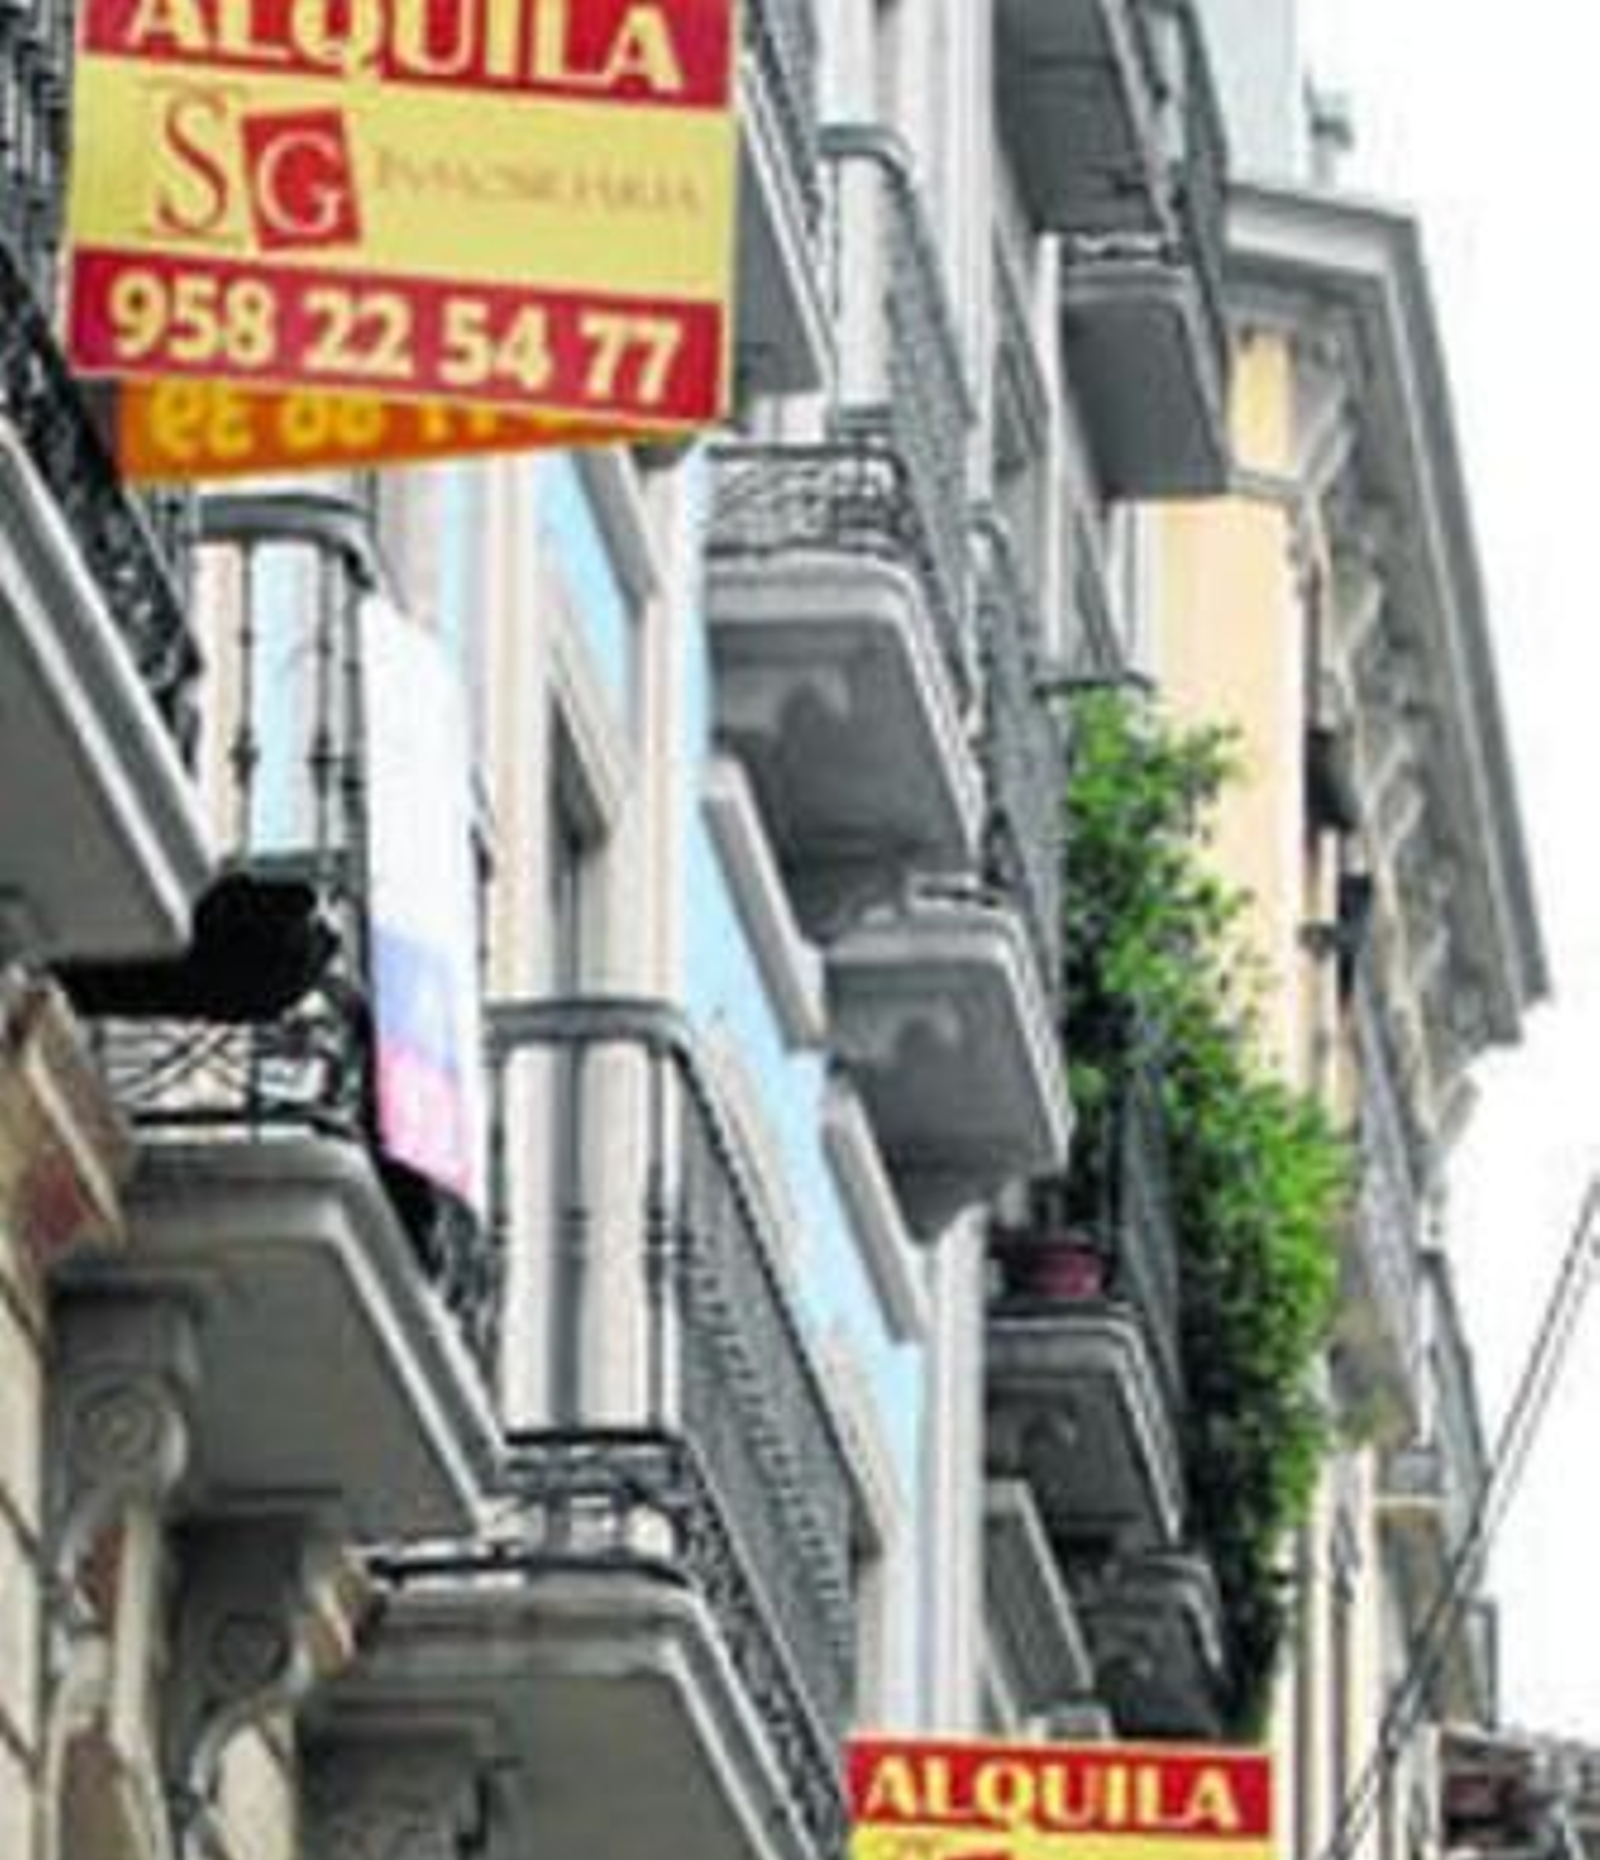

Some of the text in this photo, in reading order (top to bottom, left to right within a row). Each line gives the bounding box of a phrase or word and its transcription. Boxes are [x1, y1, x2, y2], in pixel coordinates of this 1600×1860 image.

[129, 0, 684, 91] ALQUILA
[107, 272, 683, 404] 958 22 54 77
[864, 1755, 1241, 1833] ALQUILA
